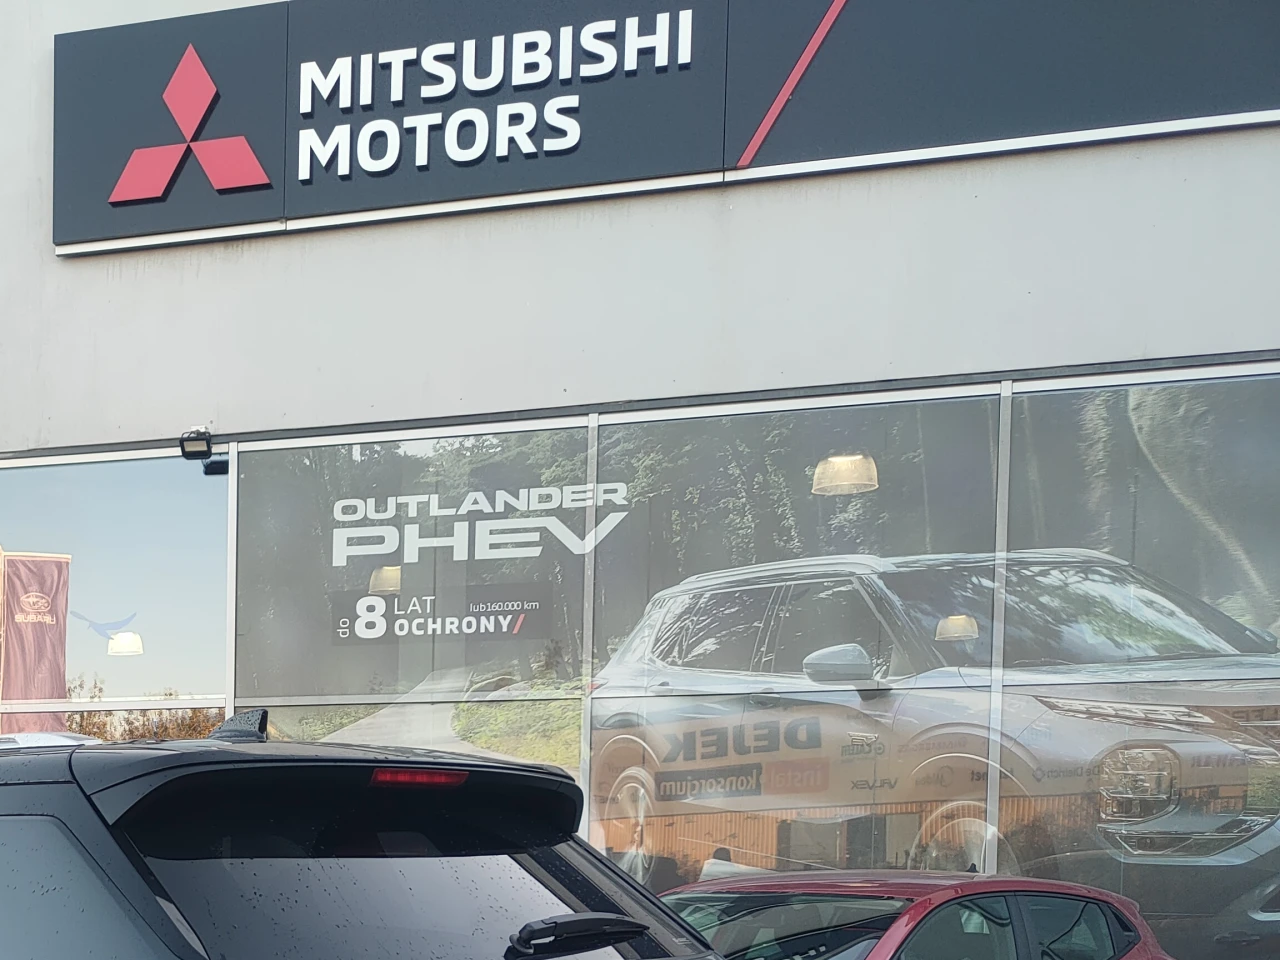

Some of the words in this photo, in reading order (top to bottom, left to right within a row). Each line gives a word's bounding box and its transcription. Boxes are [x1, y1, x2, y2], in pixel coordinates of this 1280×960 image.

[298, 8, 694, 115] MITSUBISHI
[297, 94, 582, 182] MOTORS
[333, 482, 629, 522] OUTLANDER
[332, 511, 629, 567] PHEV
[354, 595, 387, 639] 8
[394, 596, 436, 615] LAT
[523, 600, 540, 611] km
